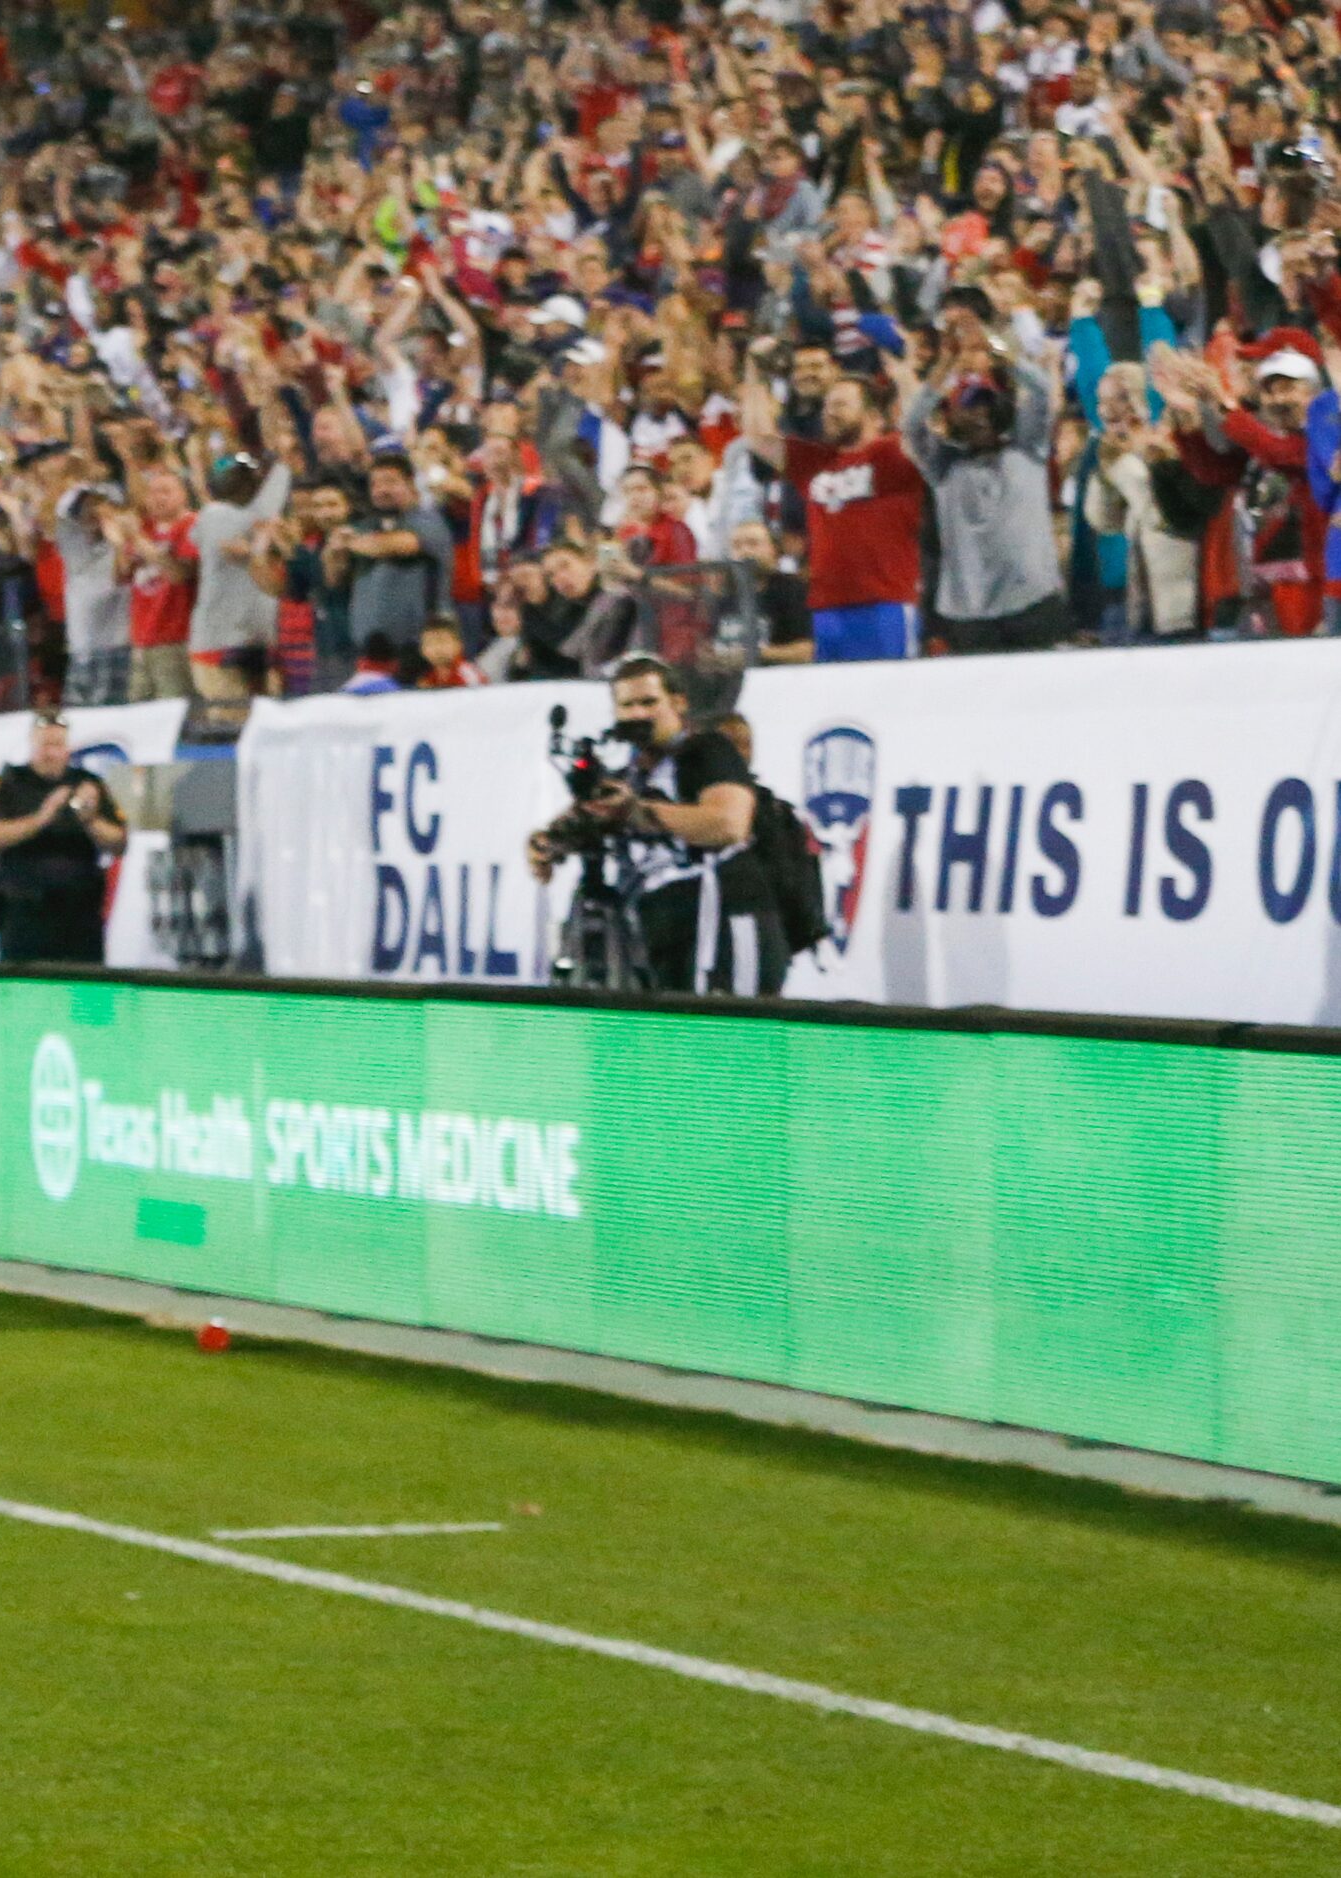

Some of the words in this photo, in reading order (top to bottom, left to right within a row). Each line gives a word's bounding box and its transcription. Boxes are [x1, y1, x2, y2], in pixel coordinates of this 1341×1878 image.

[370, 740, 441, 854] FC
[894, 779, 1084, 918] THIS
[1124, 779, 1214, 921] IS
[1258, 778, 1341, 926] O
[82, 1080, 157, 1171] Texas
[160, 1087, 253, 1181] Health
[265, 1099, 393, 1198] SPORTS
[396, 1110, 582, 1219] MEDICINE
